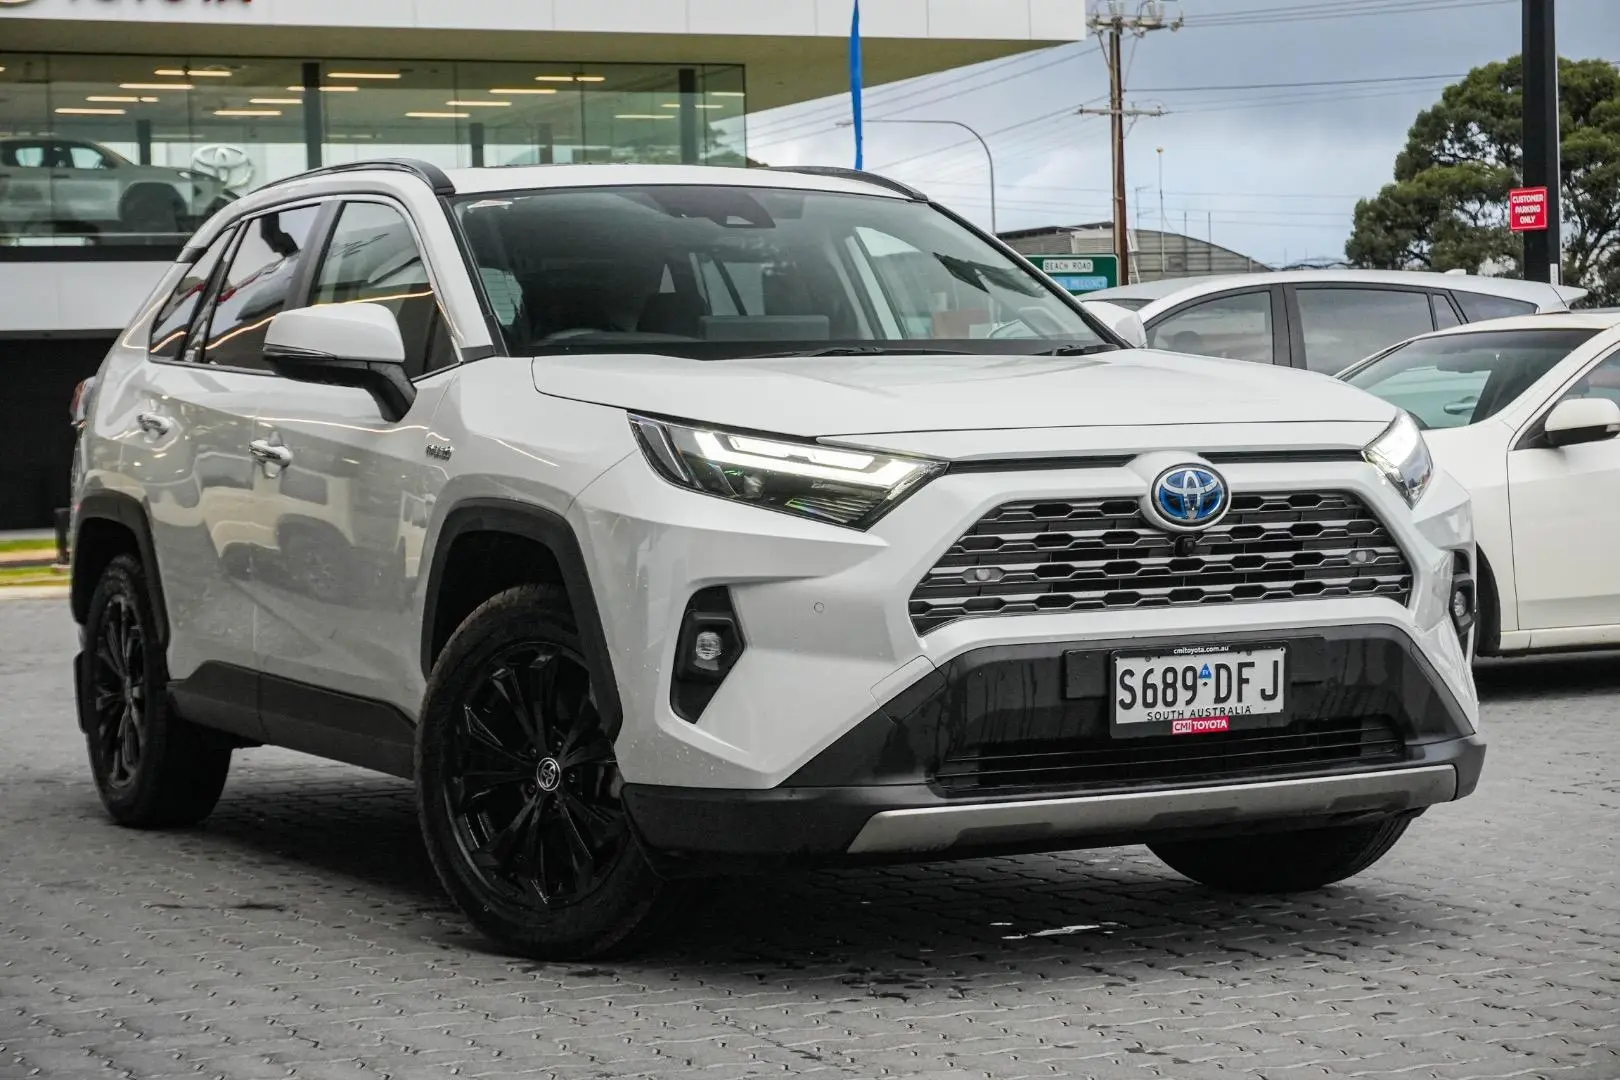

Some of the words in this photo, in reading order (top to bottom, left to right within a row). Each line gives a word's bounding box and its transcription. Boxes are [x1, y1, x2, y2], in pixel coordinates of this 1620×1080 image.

[1512, 194, 1543, 203] CUSTOMER
[1515, 205, 1540, 214] PARKING
[1520, 216, 1535, 224] ONLY
[1044, 262, 1068, 270] BEACH
[1073, 262, 1091, 270] ROAD
[1173, 645, 1229, 655] cmitoyota.com.au
[1147, 709, 1184, 721] SOUTH
[1189, 705, 1252, 718] AUSTRALIA
[1174, 720, 1192, 732] CMI
[1192, 719, 1227, 730] TOYOTA
